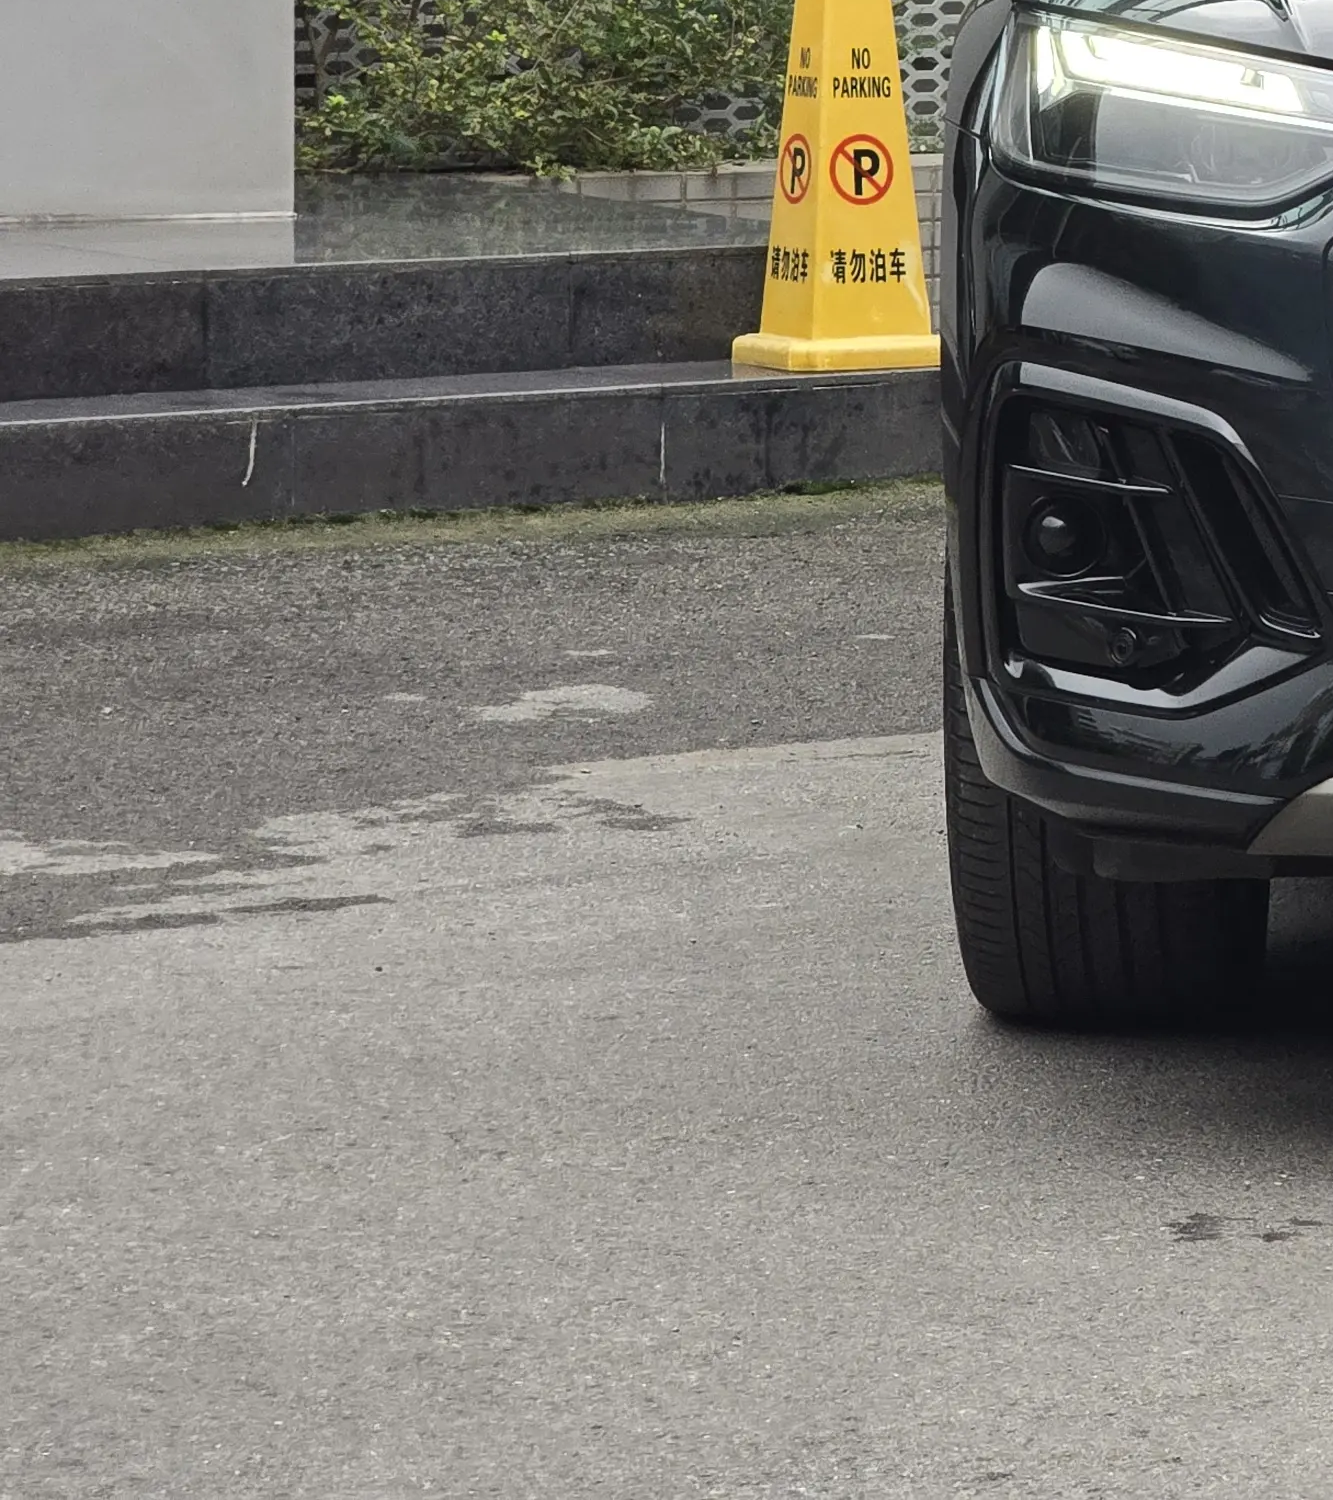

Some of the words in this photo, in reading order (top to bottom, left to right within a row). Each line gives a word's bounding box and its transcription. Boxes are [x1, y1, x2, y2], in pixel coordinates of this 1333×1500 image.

[800, 47, 811, 69] NO
[851, 48, 871, 69] NO
[788, 75, 818, 99] PARKING
[832, 76, 891, 99] PARKING
[771, 245, 810, 284] 请勿泊车
[830, 247, 906, 284] 请勿泊车
